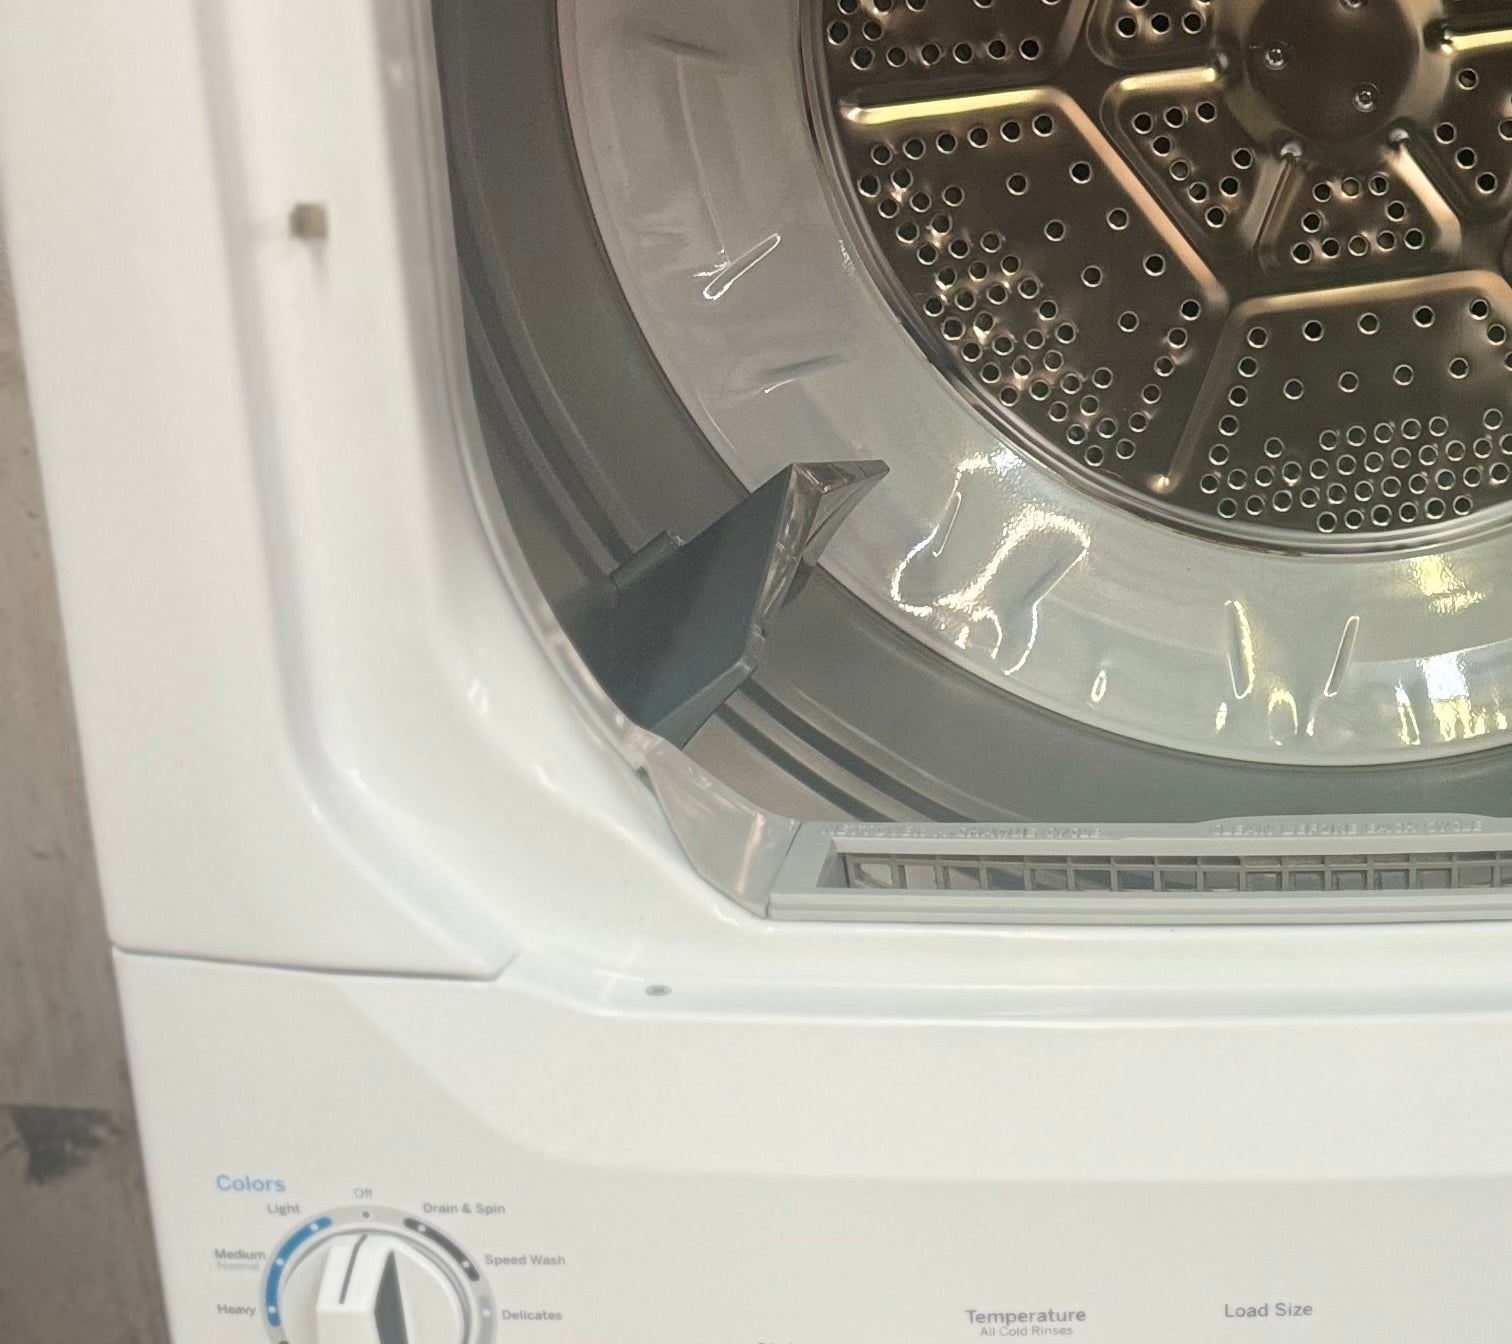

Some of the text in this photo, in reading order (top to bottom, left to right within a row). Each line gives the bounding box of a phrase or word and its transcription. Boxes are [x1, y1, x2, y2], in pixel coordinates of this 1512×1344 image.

[216, 1174, 285, 1192] Colors
[354, 1187, 373, 1199] Off
[267, 1203, 300, 1216] Light
[423, 1202, 506, 1215] Drain & Spin
[214, 1248, 267, 1260] Medium
[484, 1254, 566, 1266] Speed Wash
[217, 1304, 256, 1317] Heavy
[501, 1309, 563, 1321] Delicates
[1224, 1302, 1313, 1318] Load Size
[965, 1308, 1086, 1327] Temperature
[979, 1324, 1074, 1337] All Cold Rinses
